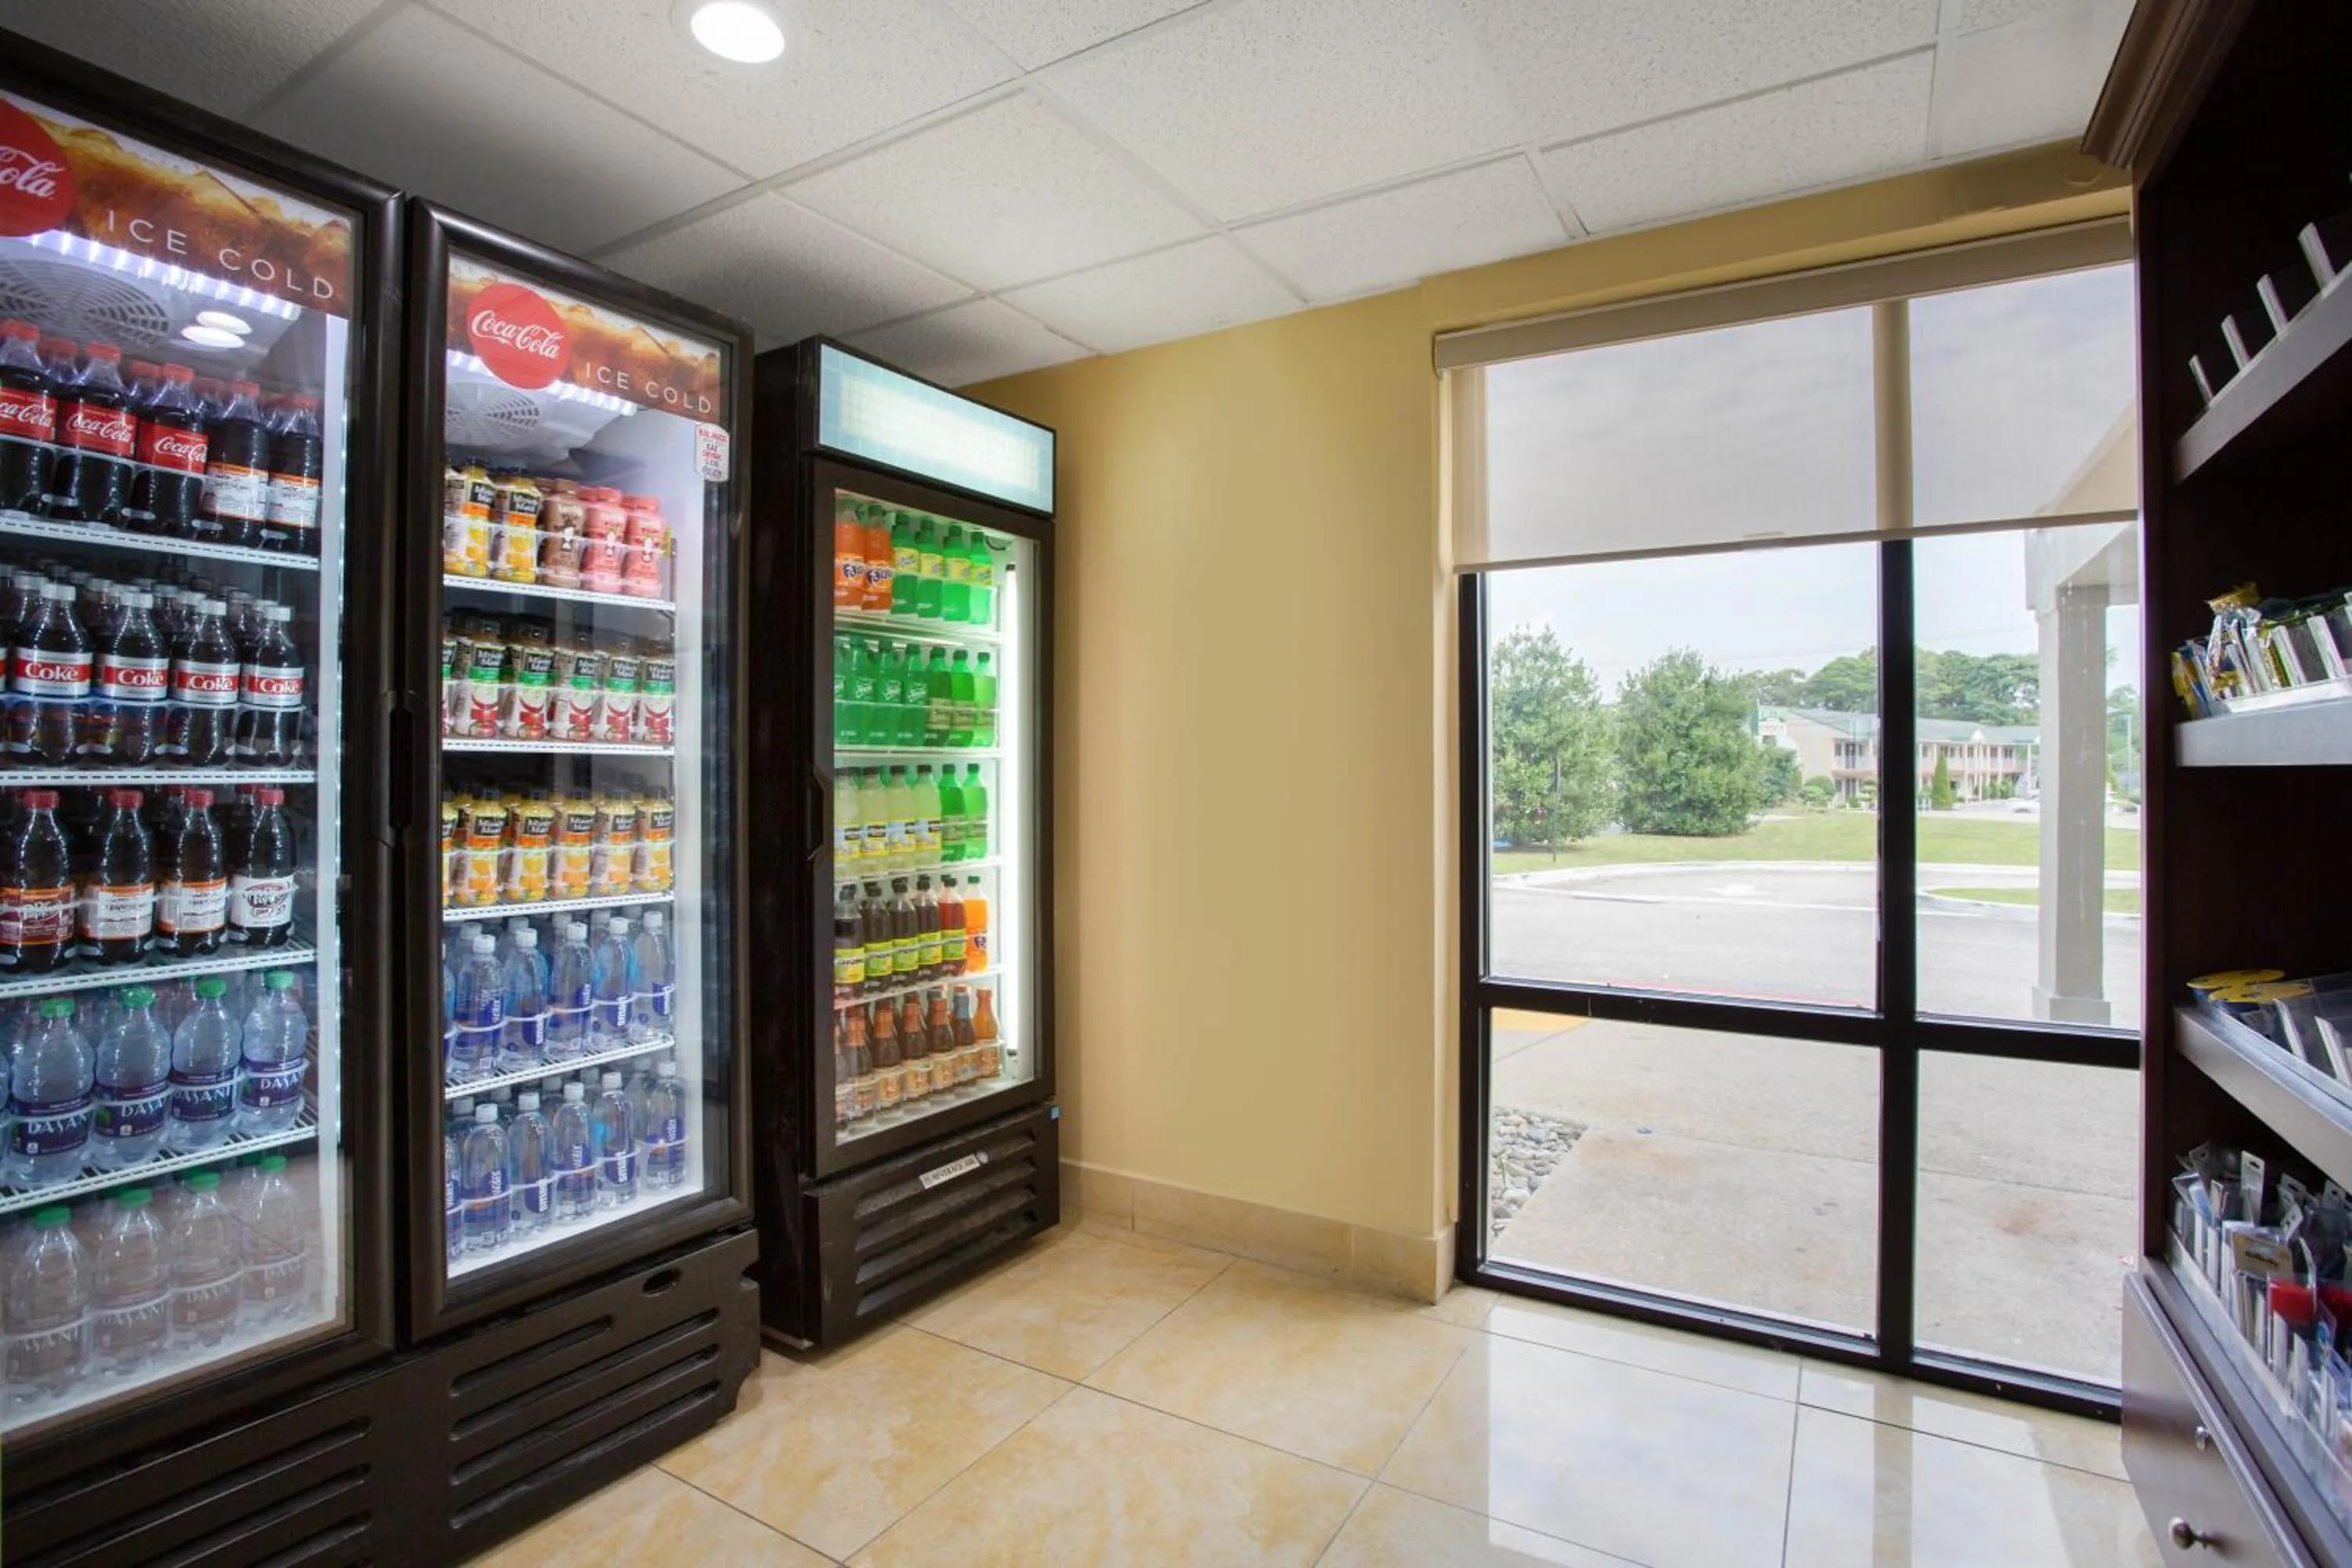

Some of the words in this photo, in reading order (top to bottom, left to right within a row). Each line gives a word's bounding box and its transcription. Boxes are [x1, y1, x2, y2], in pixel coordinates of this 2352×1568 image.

[108, 209, 187, 256] ICE
[218, 248, 334, 299] COLD
[471, 309, 564, 359] Coca-Cola
[586, 361, 629, 390] ICE
[644, 380, 712, 414] COLD
[0, 401, 53, 427] ca-Cola
[66, 412, 134, 443] Coca-Cola
[24, 662, 79, 681] Coke
[118, 669, 165, 686] Coke
[188, 675, 234, 691] Coke
[260, 678, 300, 694] Coke
